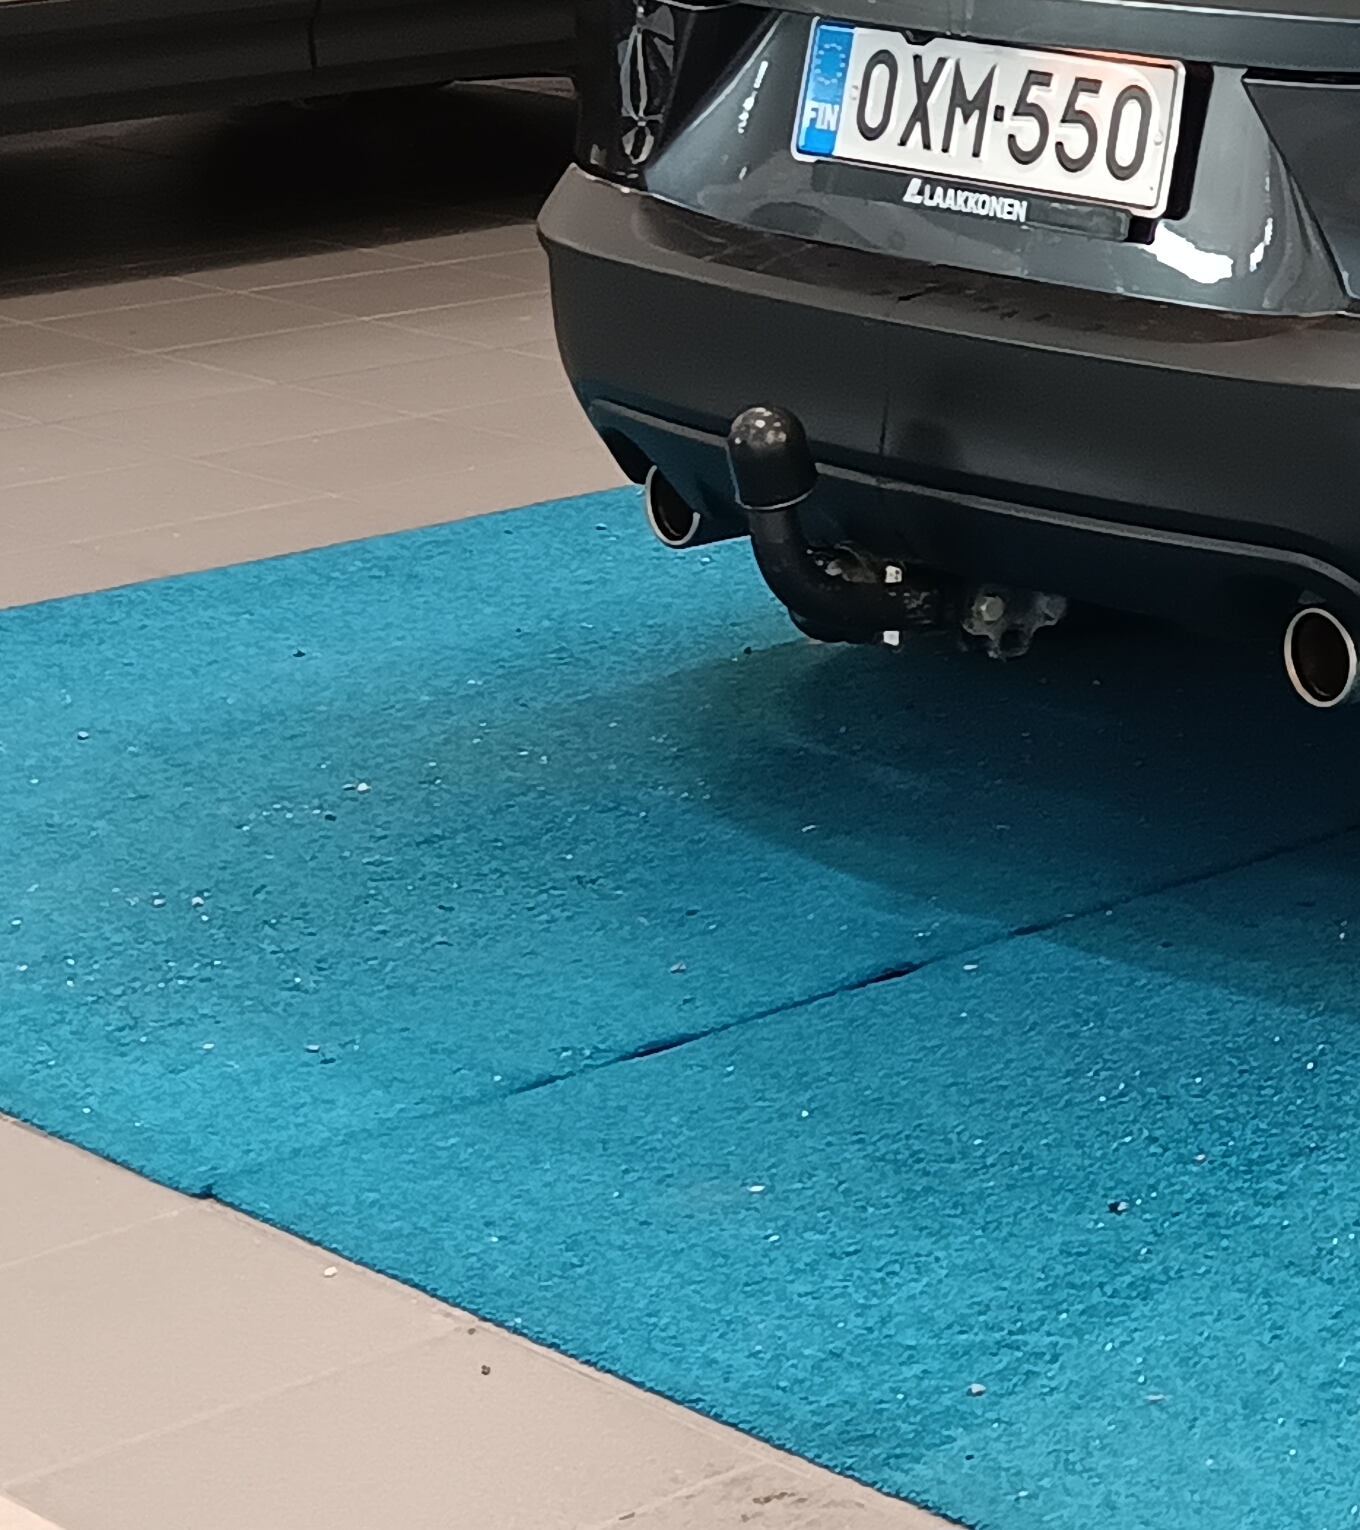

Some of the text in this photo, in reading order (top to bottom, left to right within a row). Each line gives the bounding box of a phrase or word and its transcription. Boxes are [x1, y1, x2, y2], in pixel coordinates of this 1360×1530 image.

[801, 48, 1153, 182] FIN OXM-550
[923, 183, 1028, 223] LAAKKONEN
